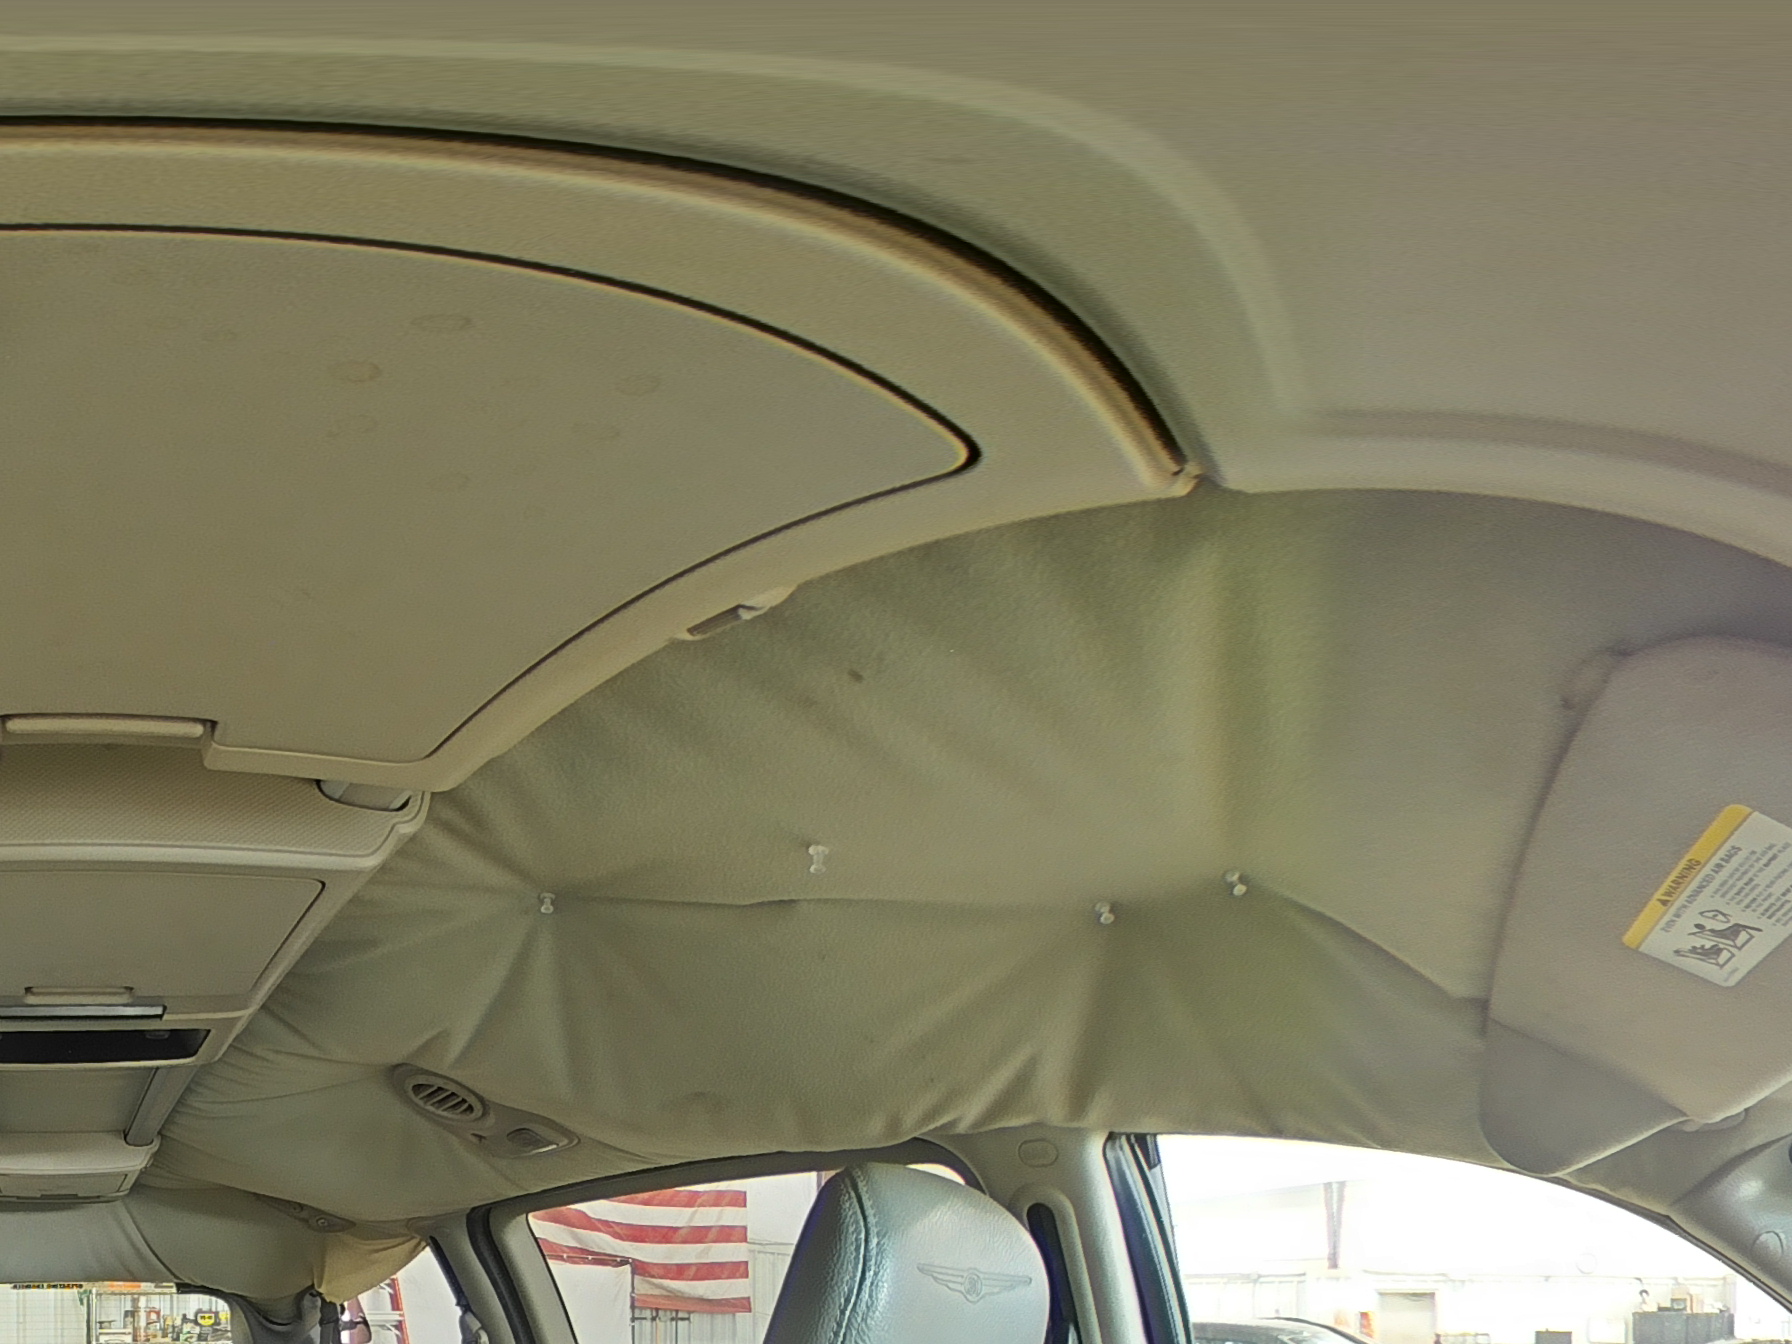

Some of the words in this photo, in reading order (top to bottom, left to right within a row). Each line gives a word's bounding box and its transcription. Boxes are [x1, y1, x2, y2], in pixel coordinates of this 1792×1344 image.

[1663, 857, 1702, 898] WARNING
[1672, 903, 1690, 918] WITH
[1683, 873, 1716, 905] ADVANCED
[1710, 862, 1726, 875] AIR
[1719, 844, 1743, 865] BAGS
